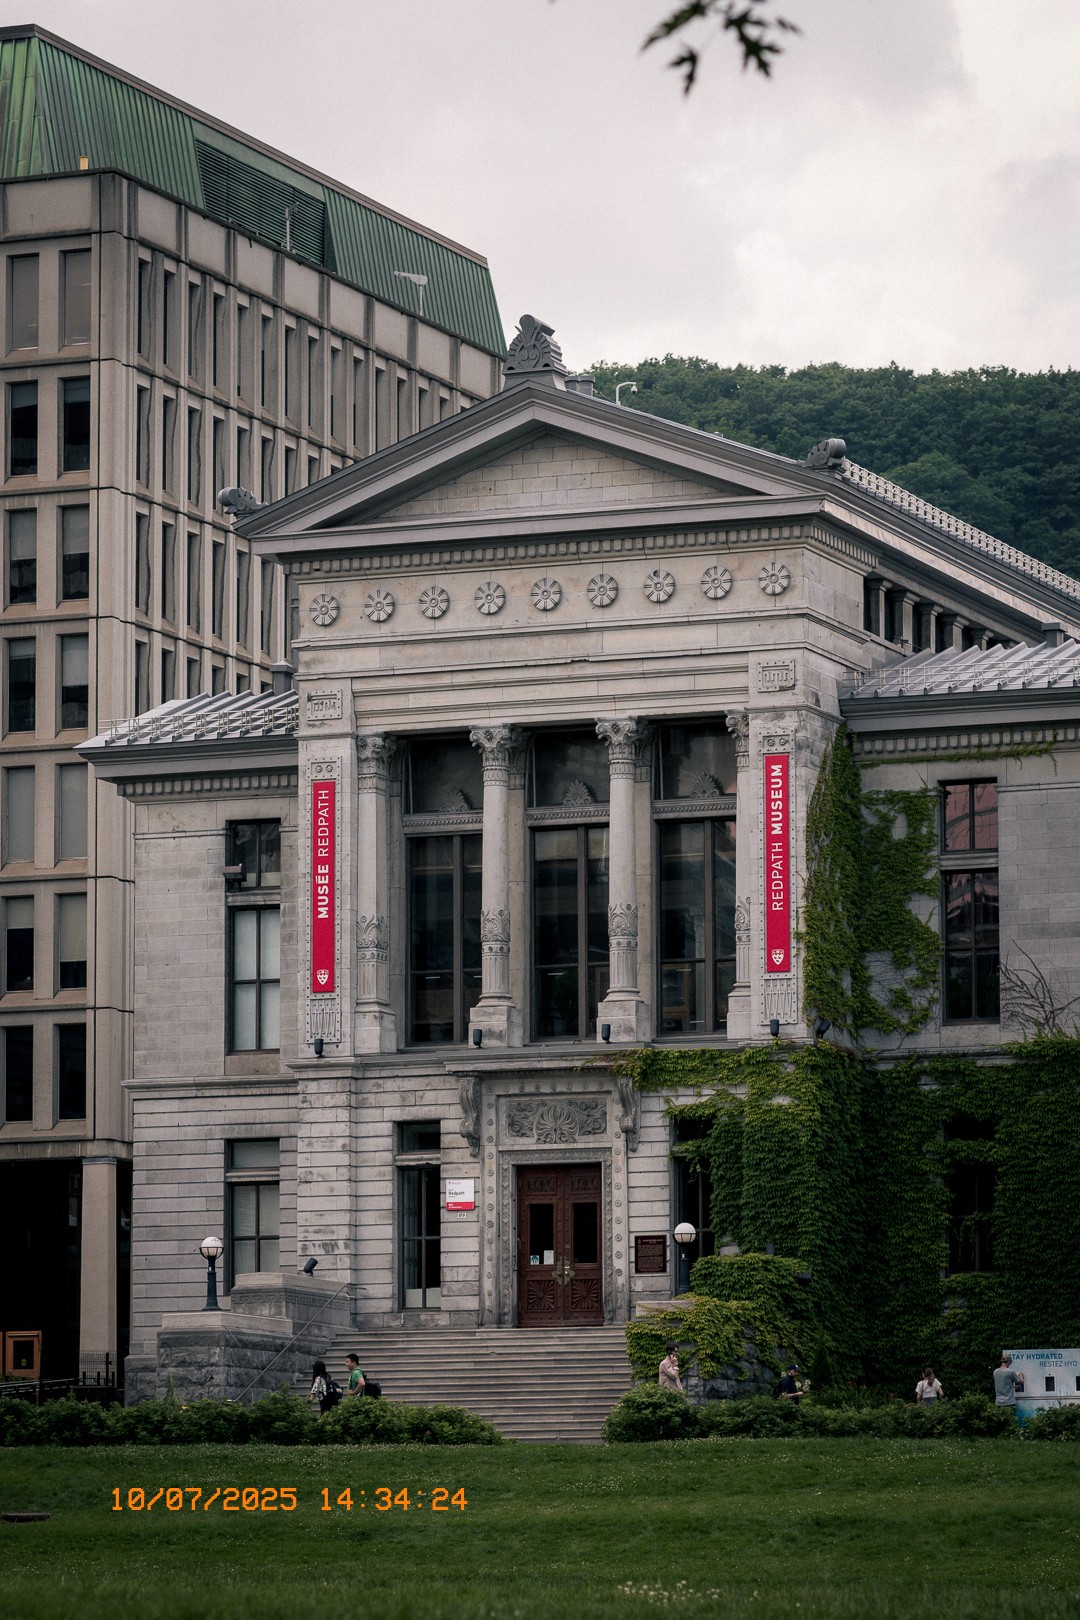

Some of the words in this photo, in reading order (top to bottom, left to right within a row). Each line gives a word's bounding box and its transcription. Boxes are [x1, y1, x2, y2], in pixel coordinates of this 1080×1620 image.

[317, 790, 329, 857] REDPATH
[770, 764, 783, 835] MUSEUM
[316, 864, 329, 919] MUSÉE
[771, 842, 783, 911] REDPATH
